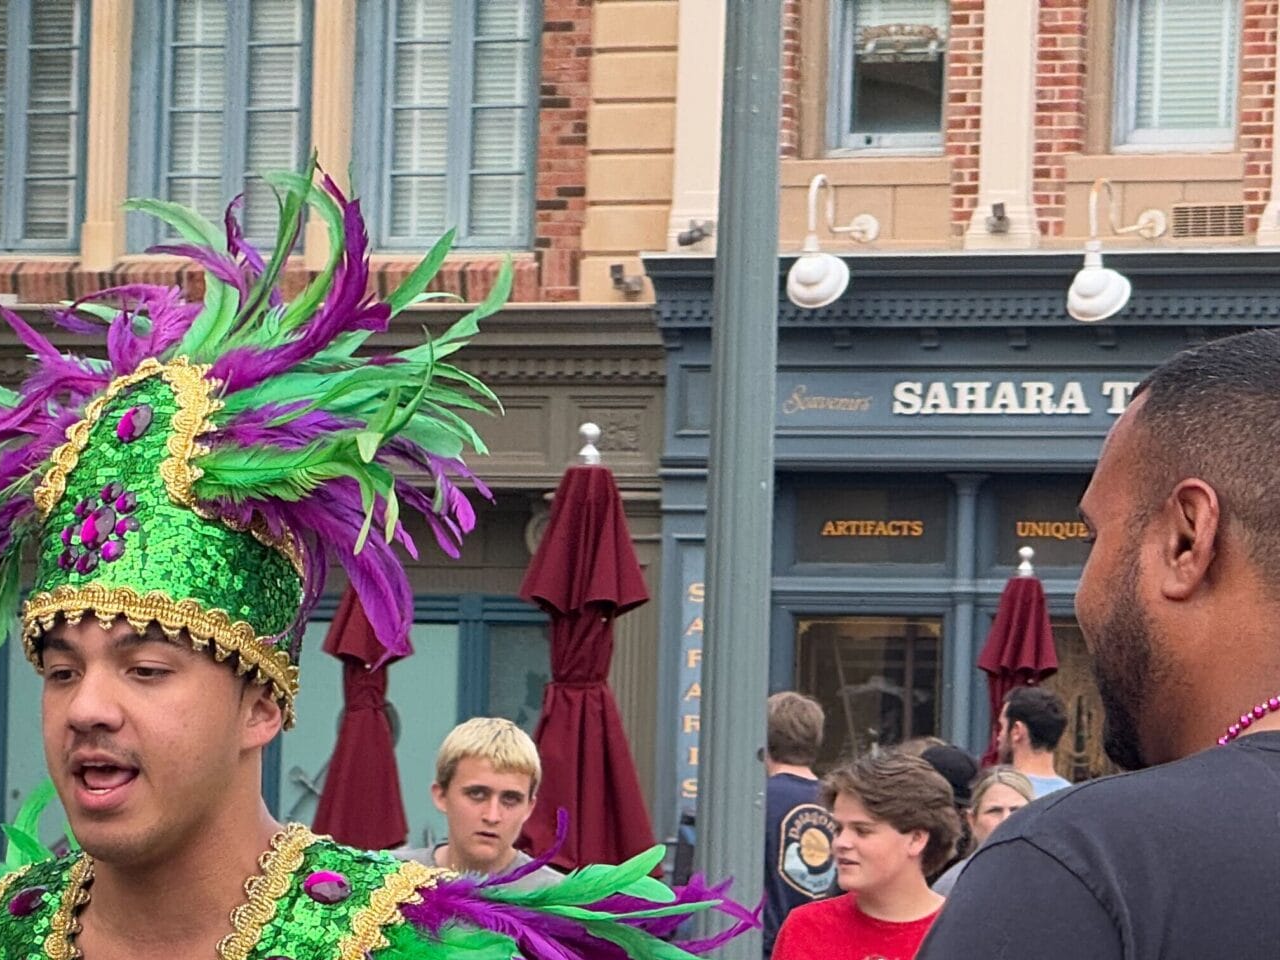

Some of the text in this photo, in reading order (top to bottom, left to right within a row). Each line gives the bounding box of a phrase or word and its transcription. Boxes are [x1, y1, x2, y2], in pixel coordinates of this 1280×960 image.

[893, 381, 1091, 415] SAHARA
[821, 520, 924, 537] ARTIFACTS
[1015, 521, 1090, 540] UNIQUE
[682, 582, 705, 798] SAFARIS
